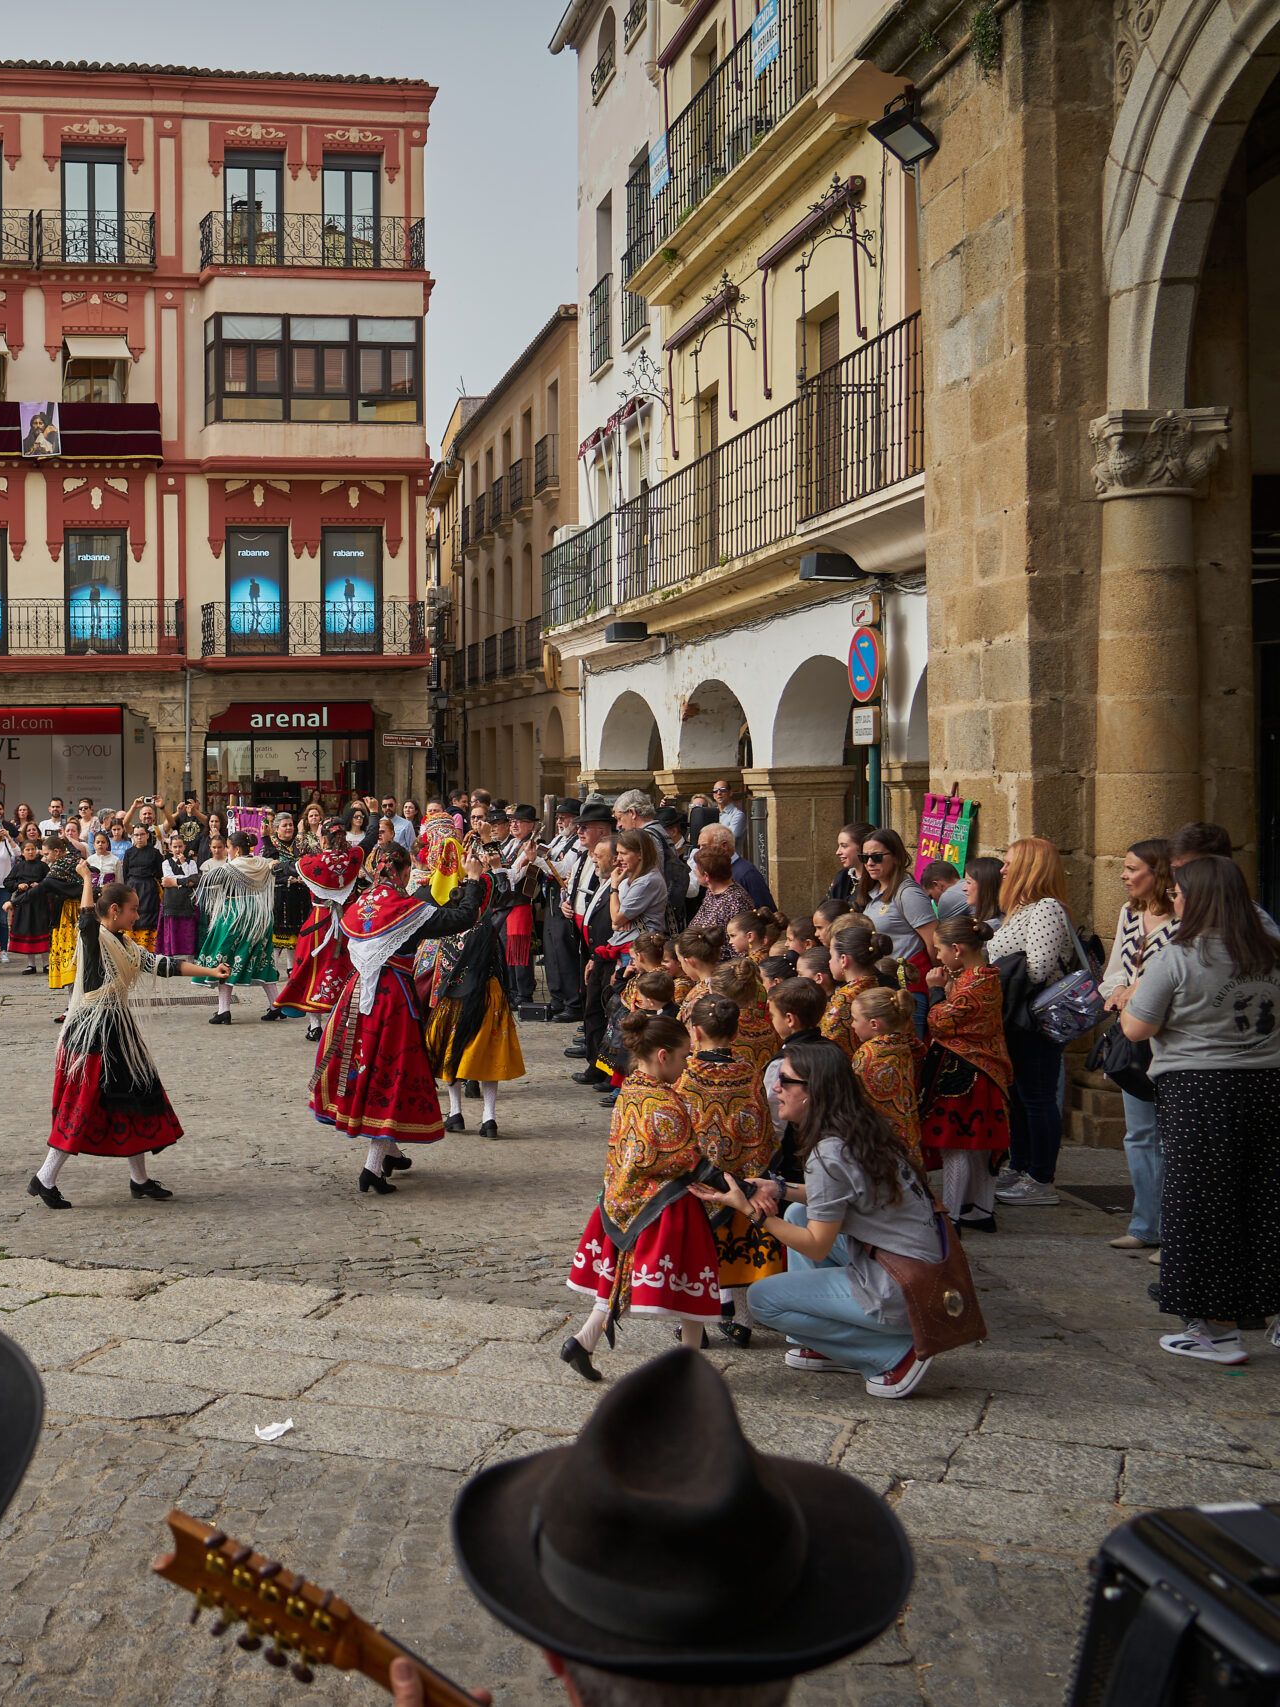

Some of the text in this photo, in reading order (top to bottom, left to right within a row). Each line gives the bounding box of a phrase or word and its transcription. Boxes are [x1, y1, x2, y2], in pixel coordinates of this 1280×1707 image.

[77, 553, 111, 561] rabanne
[237, 549, 270, 557] rabanne
[333, 549, 365, 557] rabanne
[250, 706, 328, 728] arenal
[1212, 980, 1236, 1008] GRUPO
